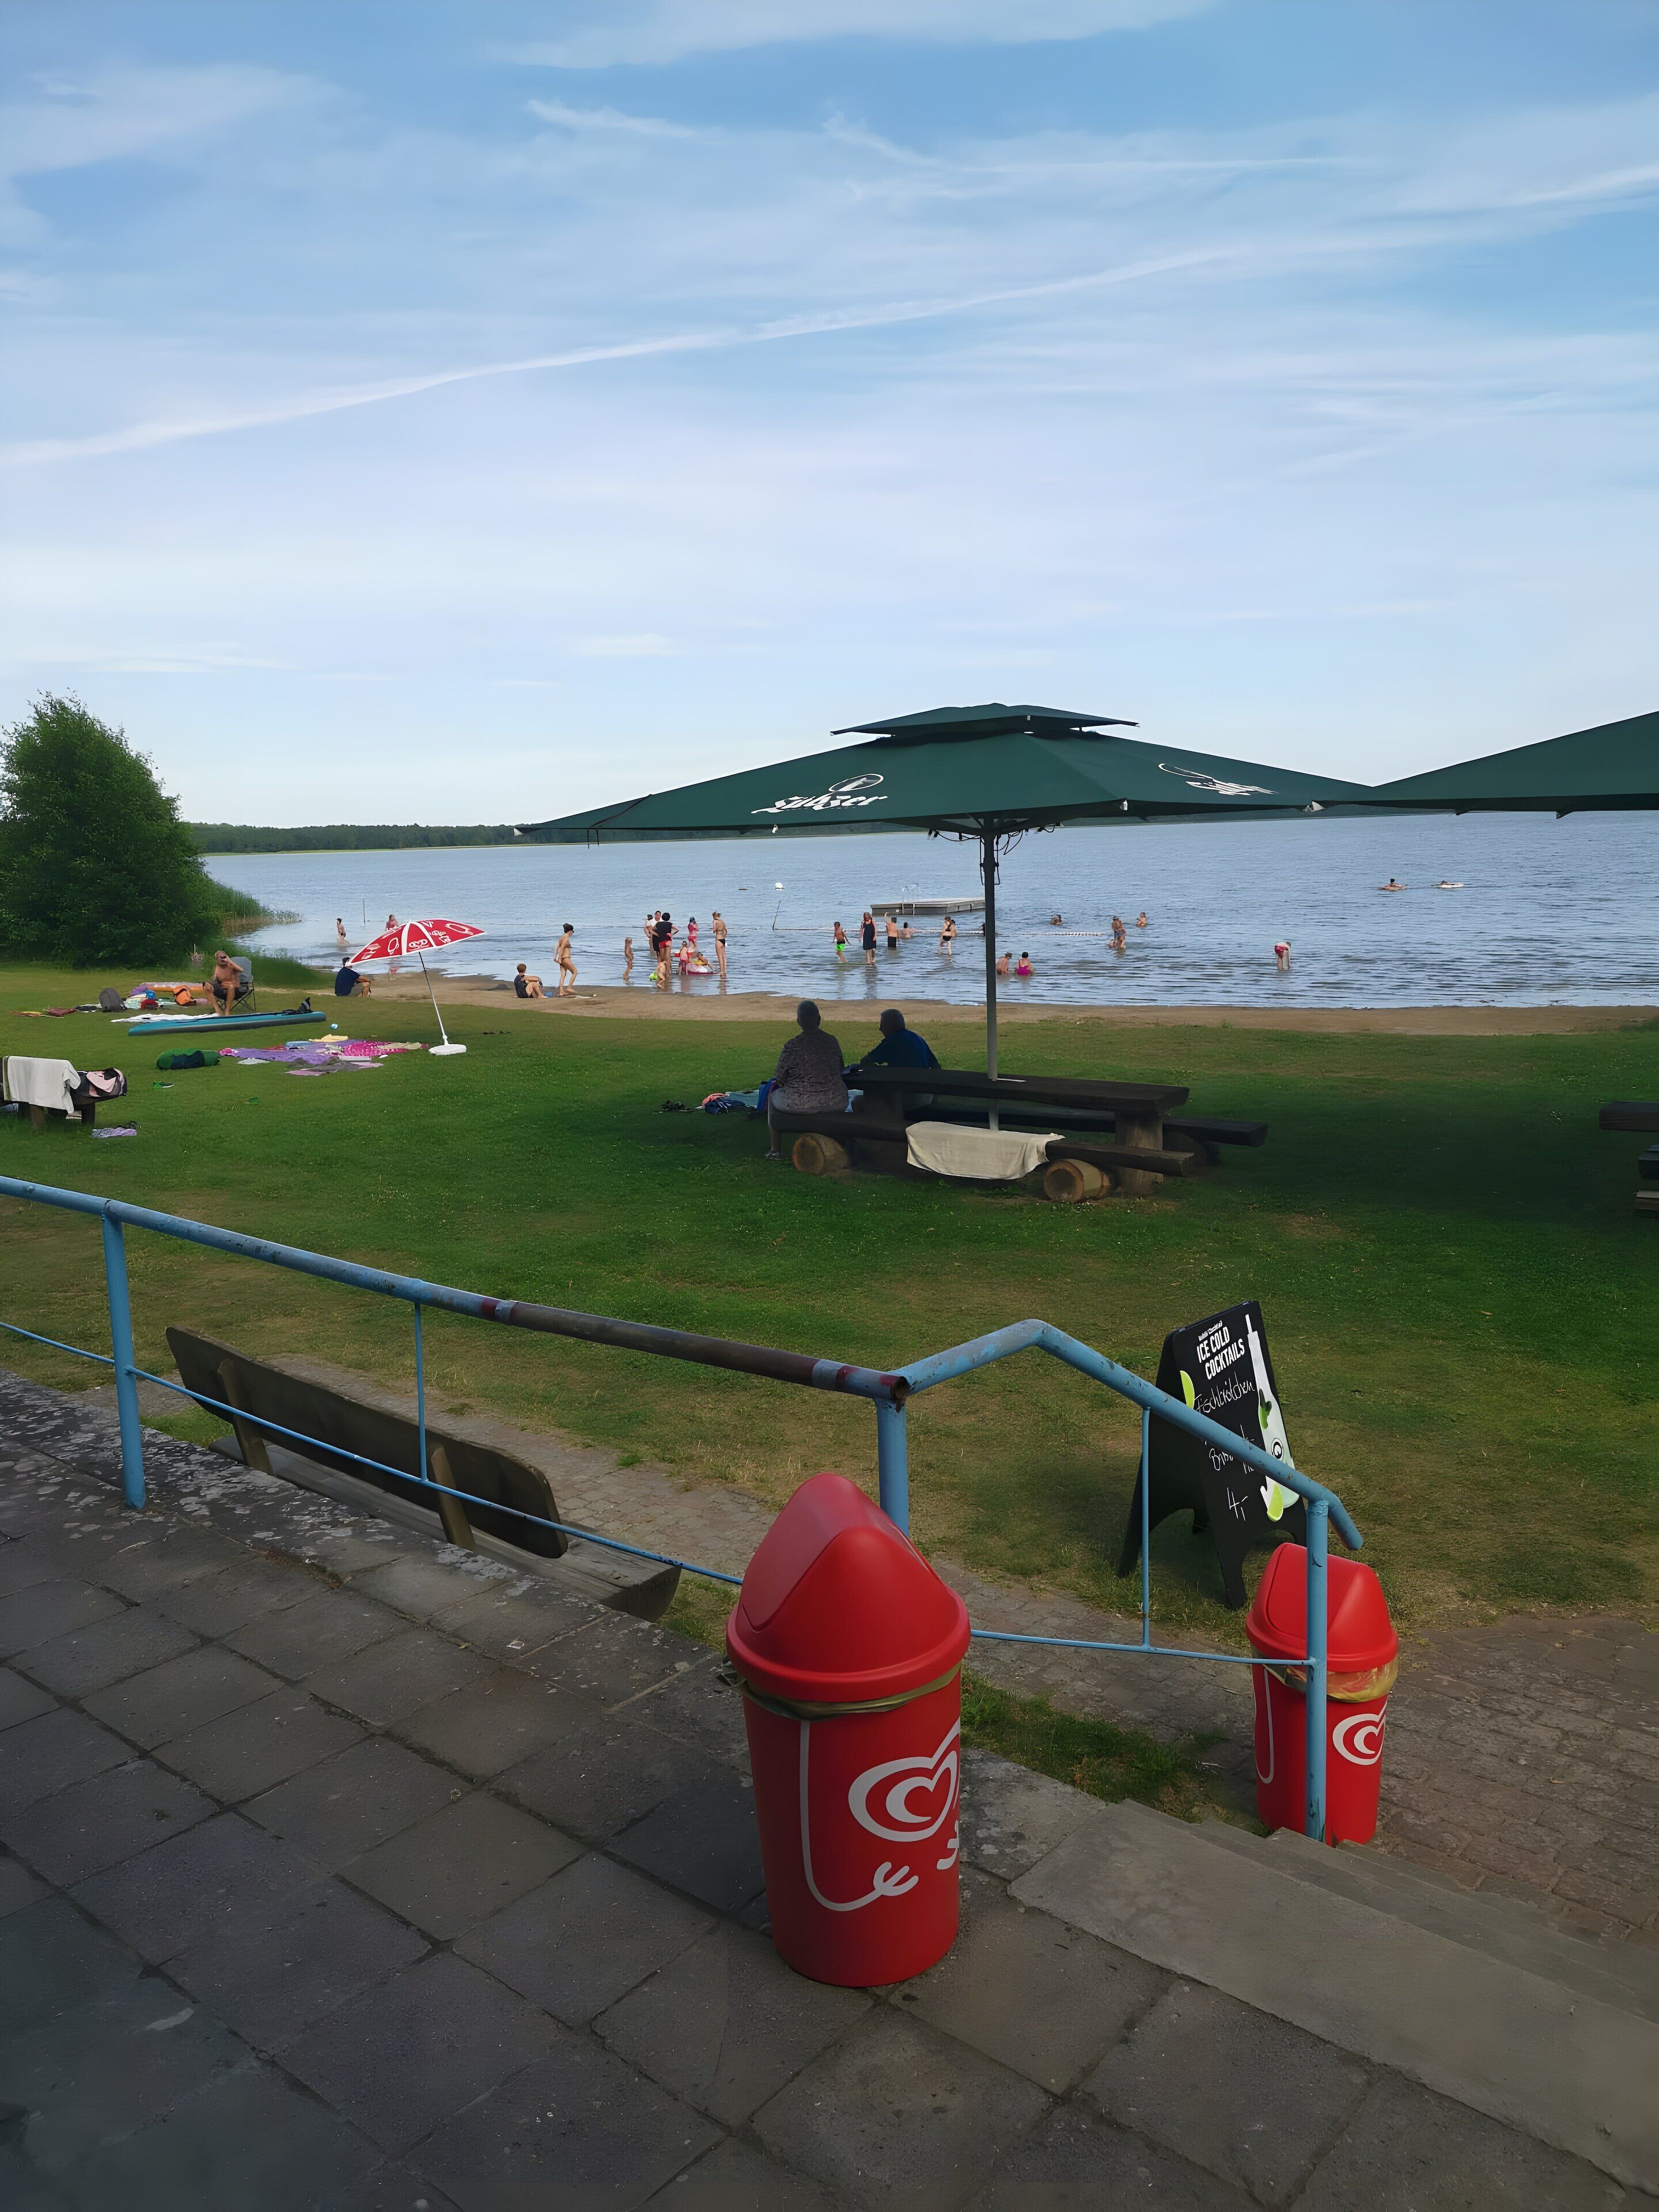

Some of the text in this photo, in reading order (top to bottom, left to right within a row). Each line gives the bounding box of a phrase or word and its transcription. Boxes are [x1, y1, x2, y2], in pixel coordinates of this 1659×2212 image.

[1196, 1339, 1211, 1363] ICE
[1210, 1326, 1230, 1353] COLD
[1205, 1338, 1245, 1380] COCKTAILS
